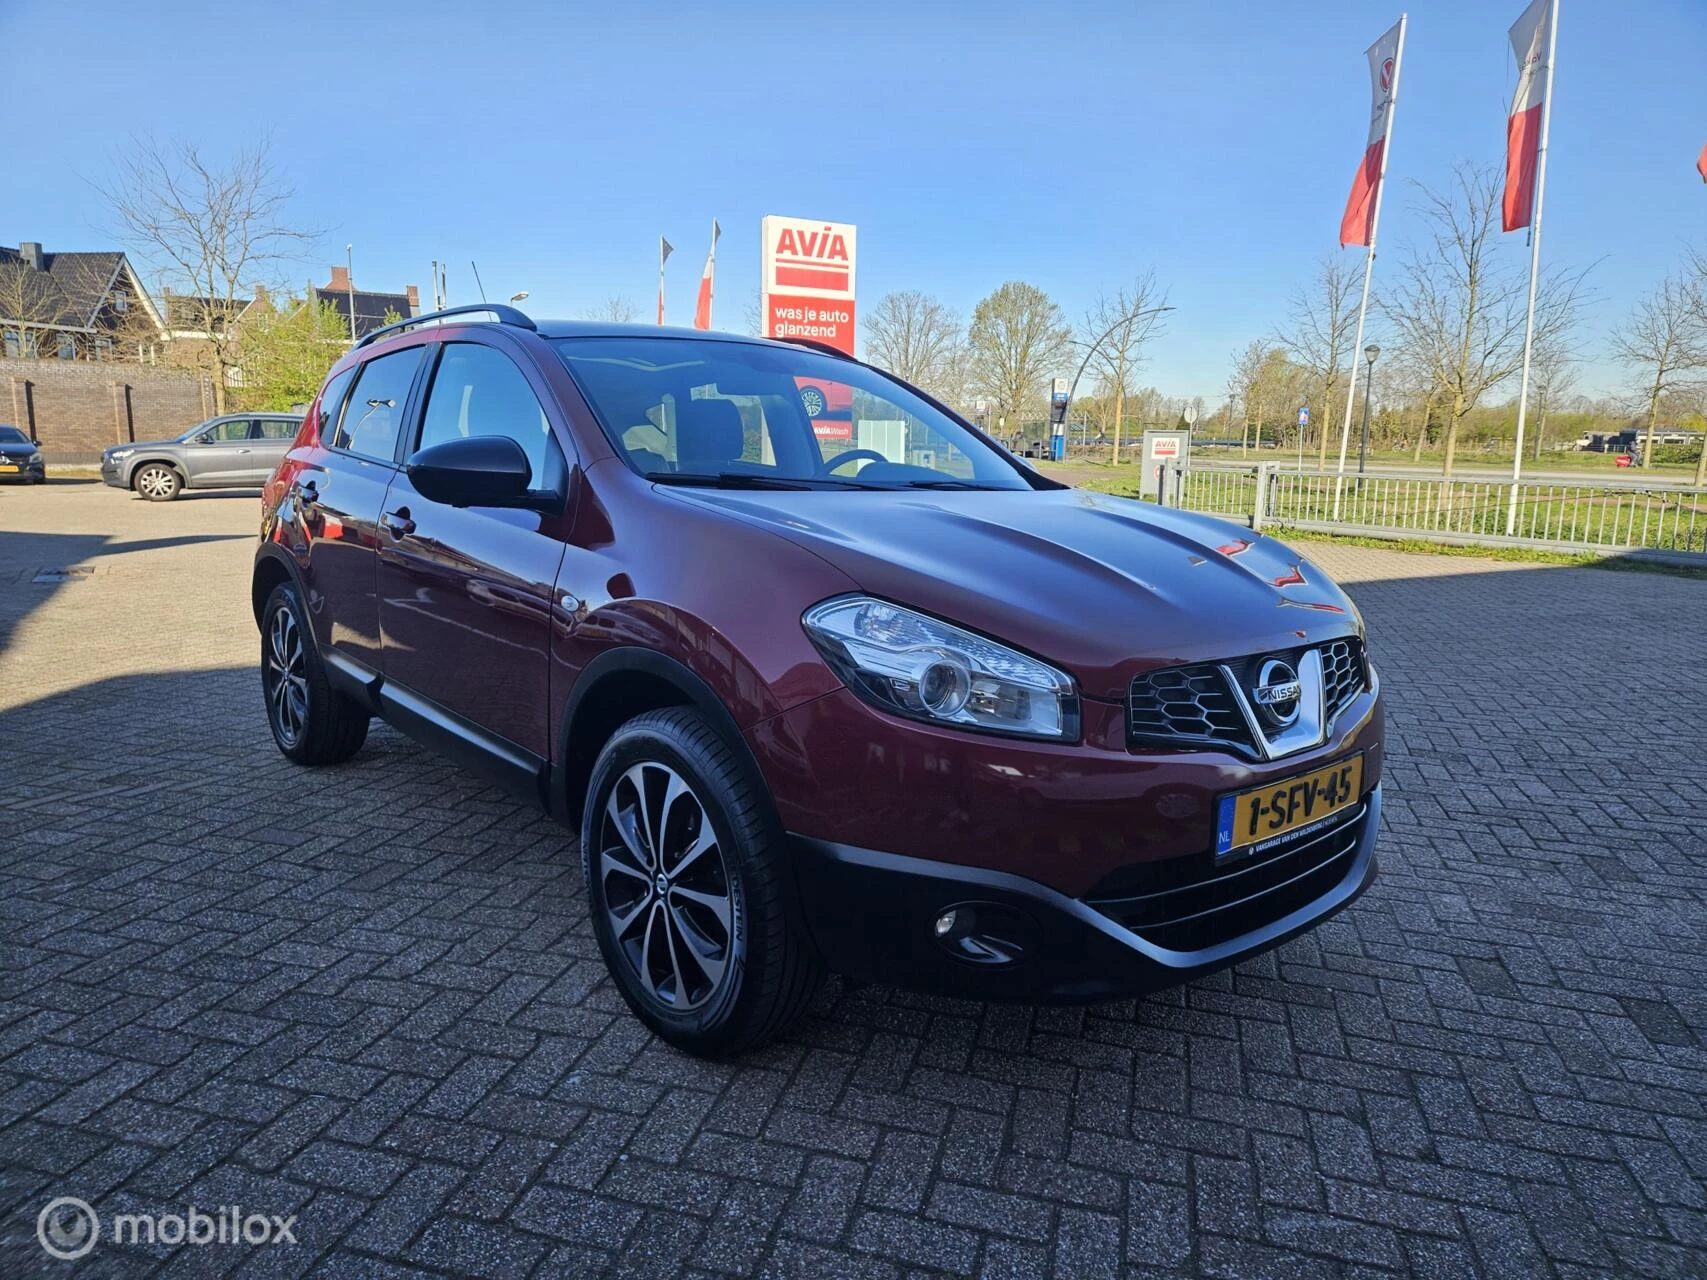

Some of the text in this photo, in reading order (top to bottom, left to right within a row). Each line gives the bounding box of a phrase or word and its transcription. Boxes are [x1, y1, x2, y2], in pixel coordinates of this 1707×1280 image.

[775, 226, 849, 261] AVIA
[775, 306, 849, 323] was je auto
[775, 321, 837, 338] glanzend
[1155, 440, 1176, 448] AVIA
[1249, 766, 1352, 835] 1-SFV-45
[1219, 831, 1230, 844] NL
